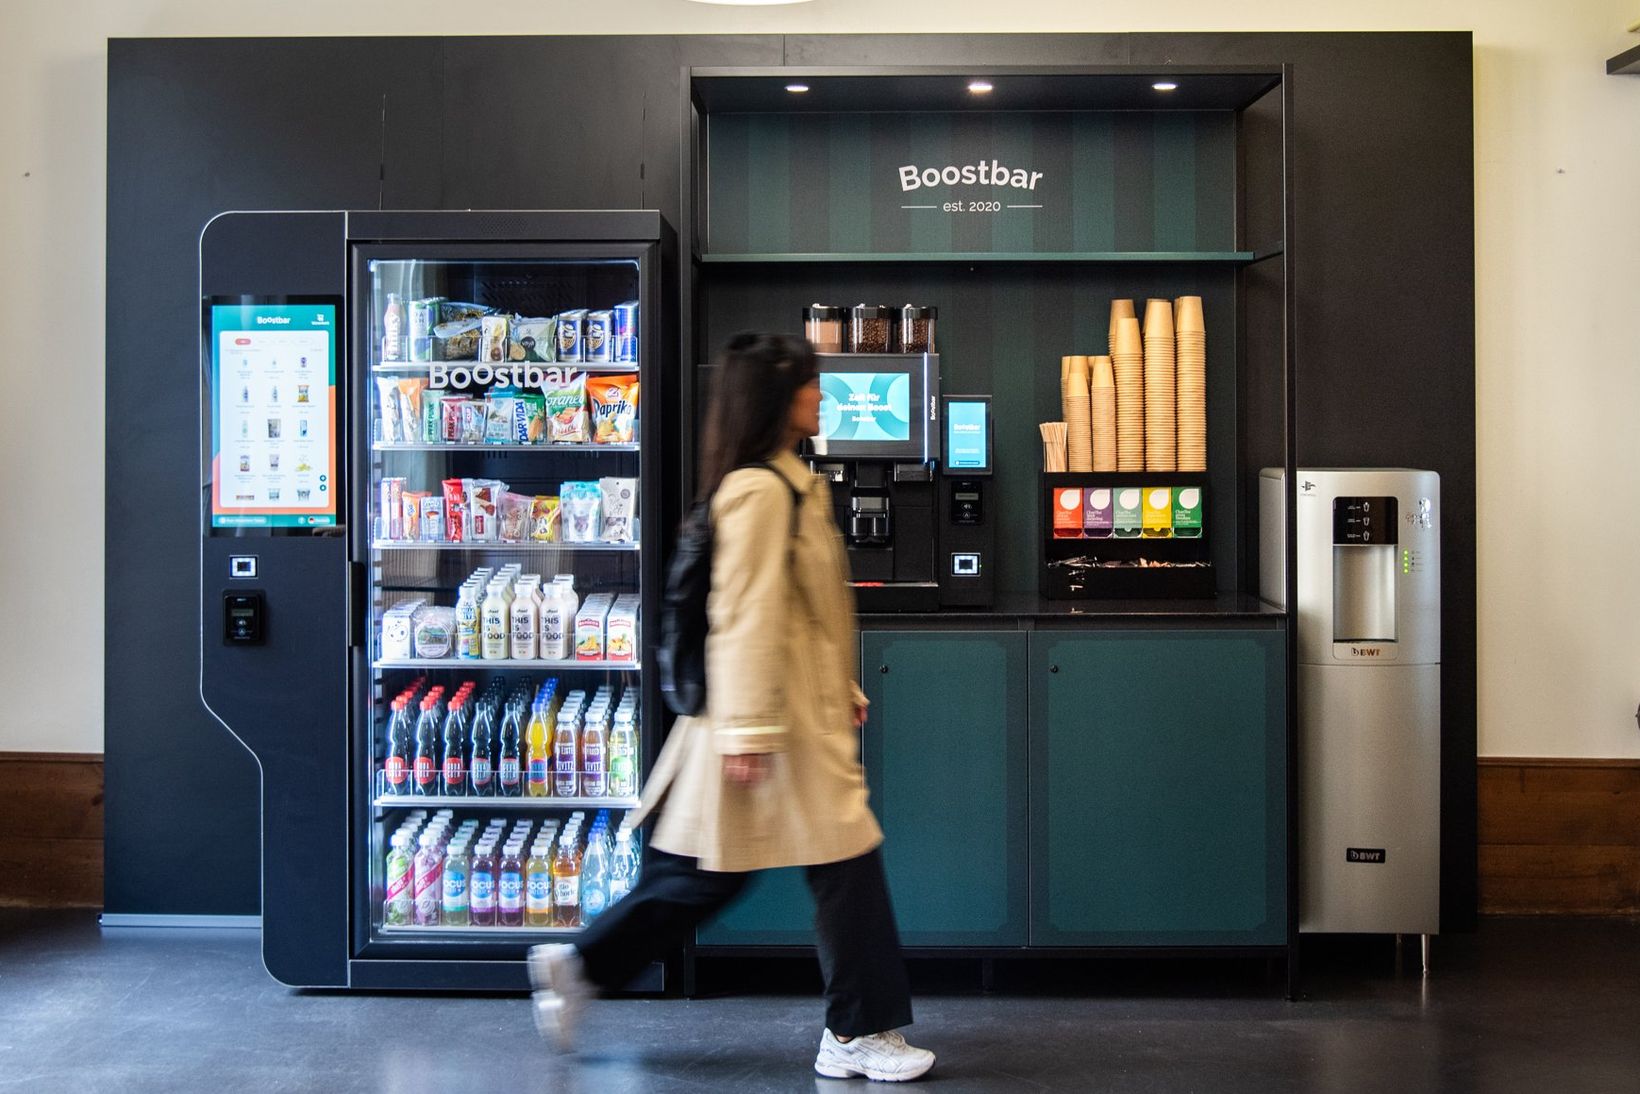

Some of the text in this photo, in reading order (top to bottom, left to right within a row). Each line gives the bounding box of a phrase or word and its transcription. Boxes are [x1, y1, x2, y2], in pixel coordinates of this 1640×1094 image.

[898, 160, 1043, 192] Boostbar
[943, 200, 1002, 212] est. 2020
[429, 361, 578, 389] Boostbar
[592, 398, 632, 418] Paprika
[1360, 648, 1382, 657] BWT
[1359, 852, 1380, 860] BWT
